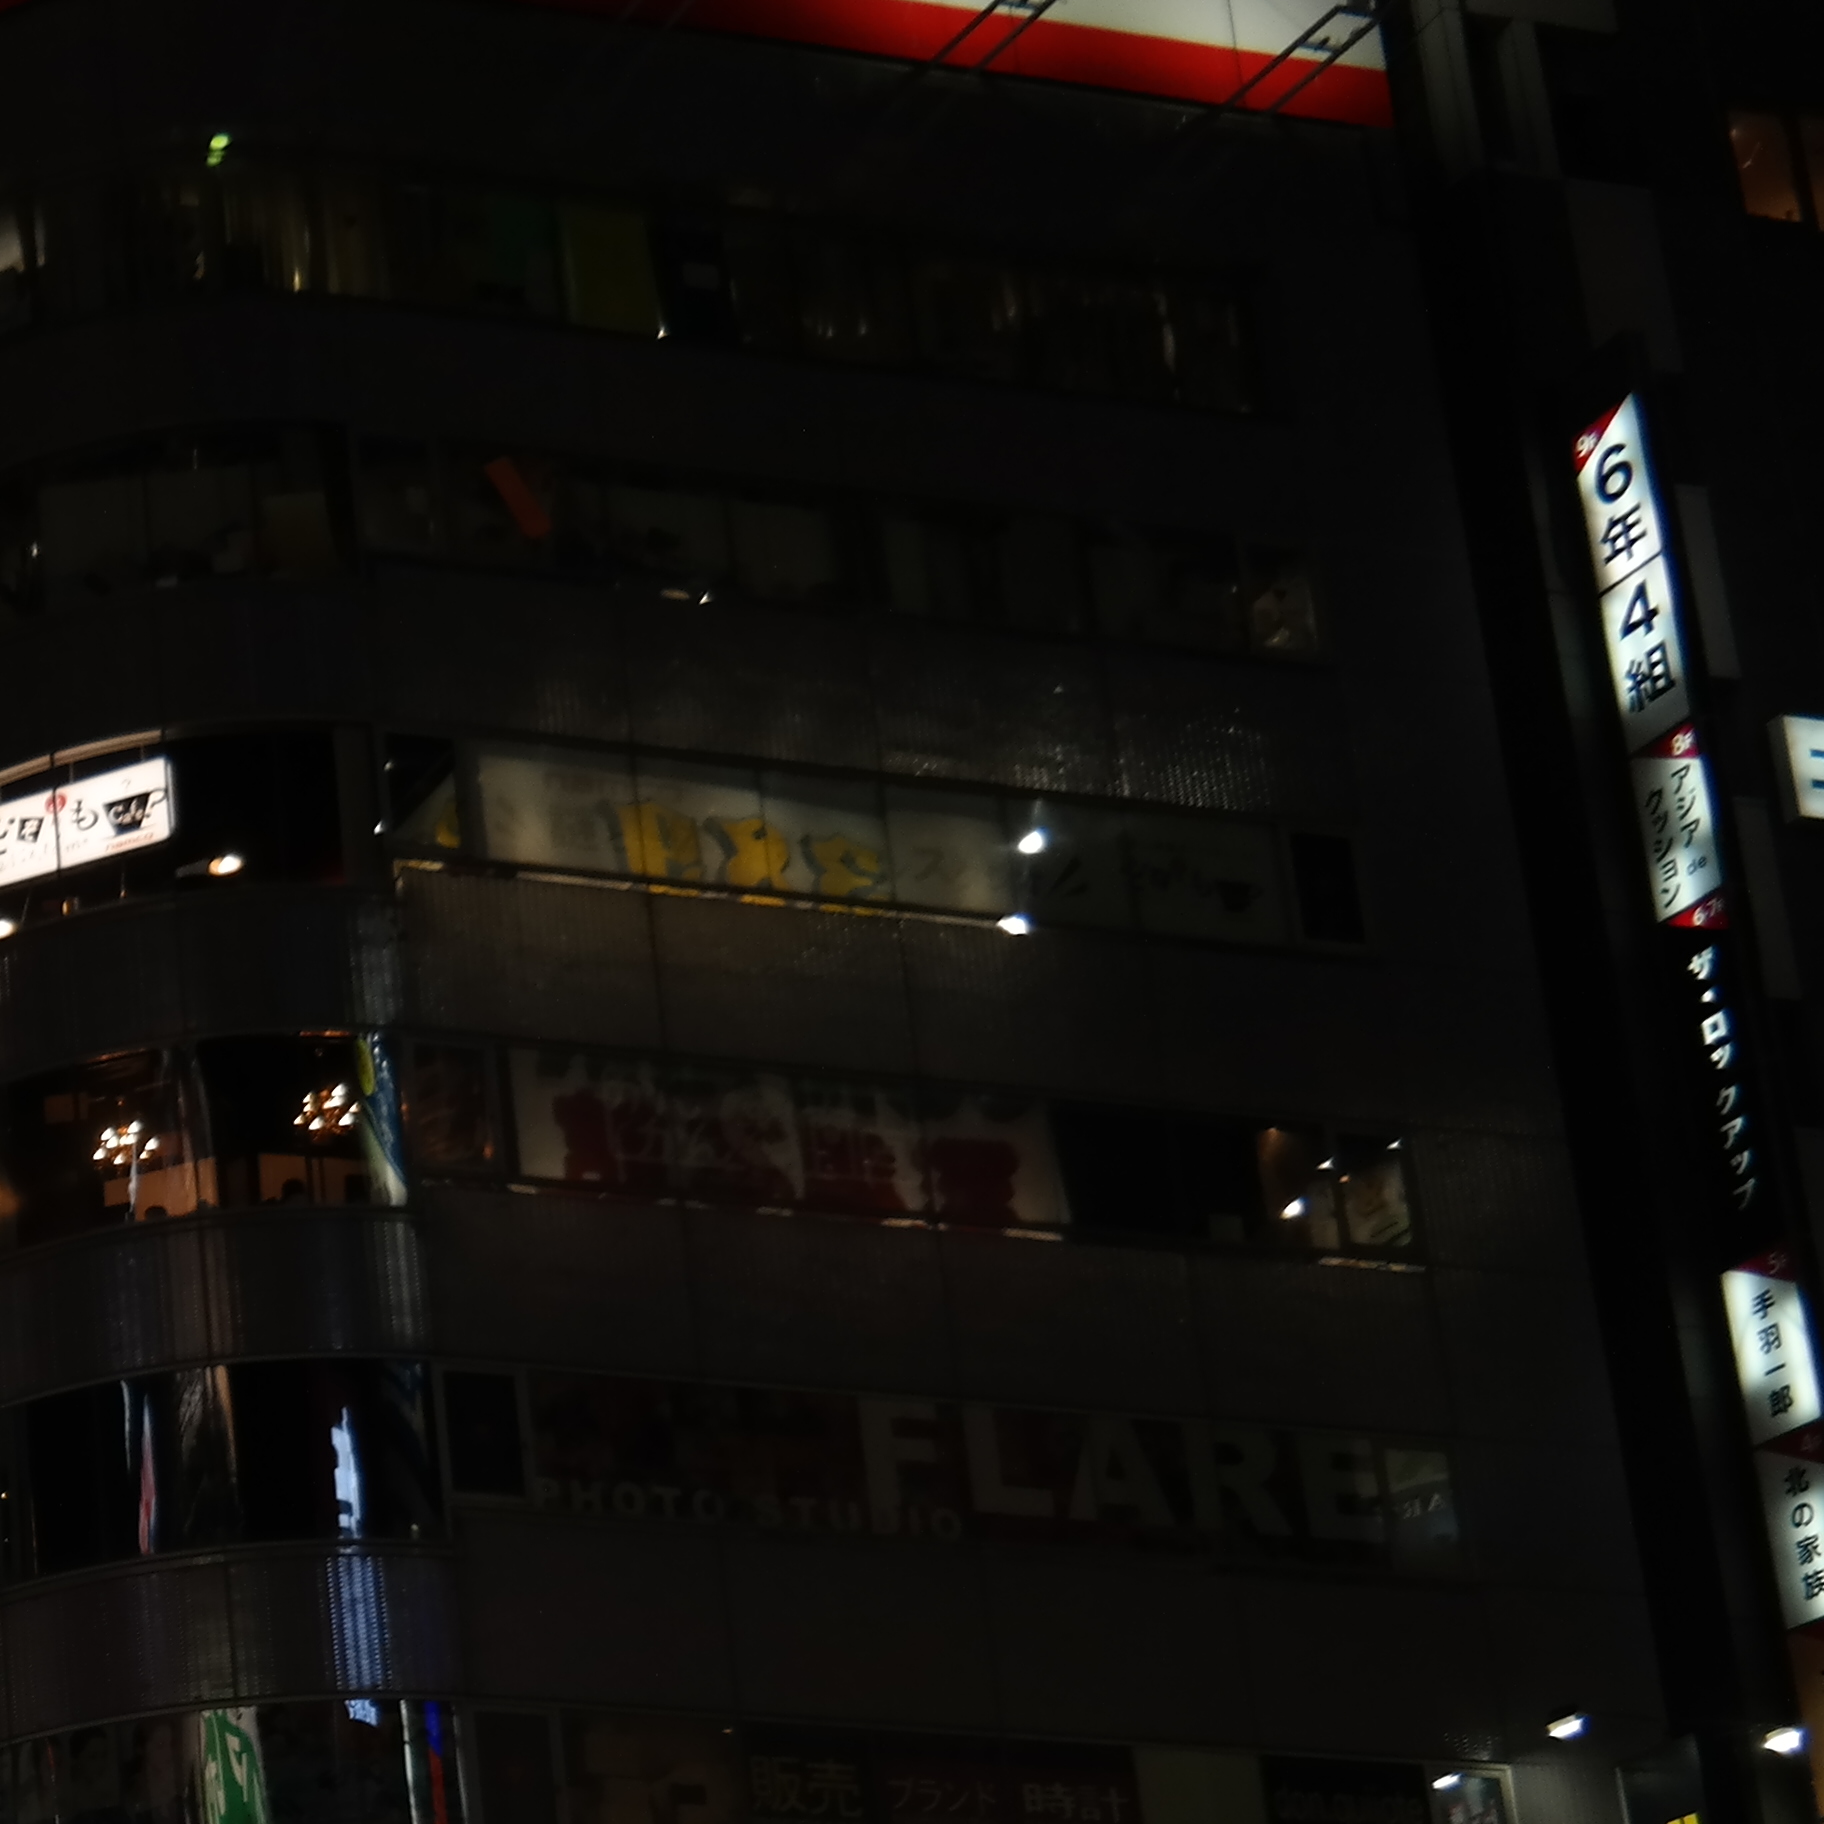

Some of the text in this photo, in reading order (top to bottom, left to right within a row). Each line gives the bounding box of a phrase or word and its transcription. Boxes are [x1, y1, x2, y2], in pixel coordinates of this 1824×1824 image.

[1594, 443, 1676, 714] 6年4組
[533, 1473, 729, 1520] PHOTO
[857, 1396, 1382, 1540] FLARE
[750, 1756, 863, 1817] 販売
